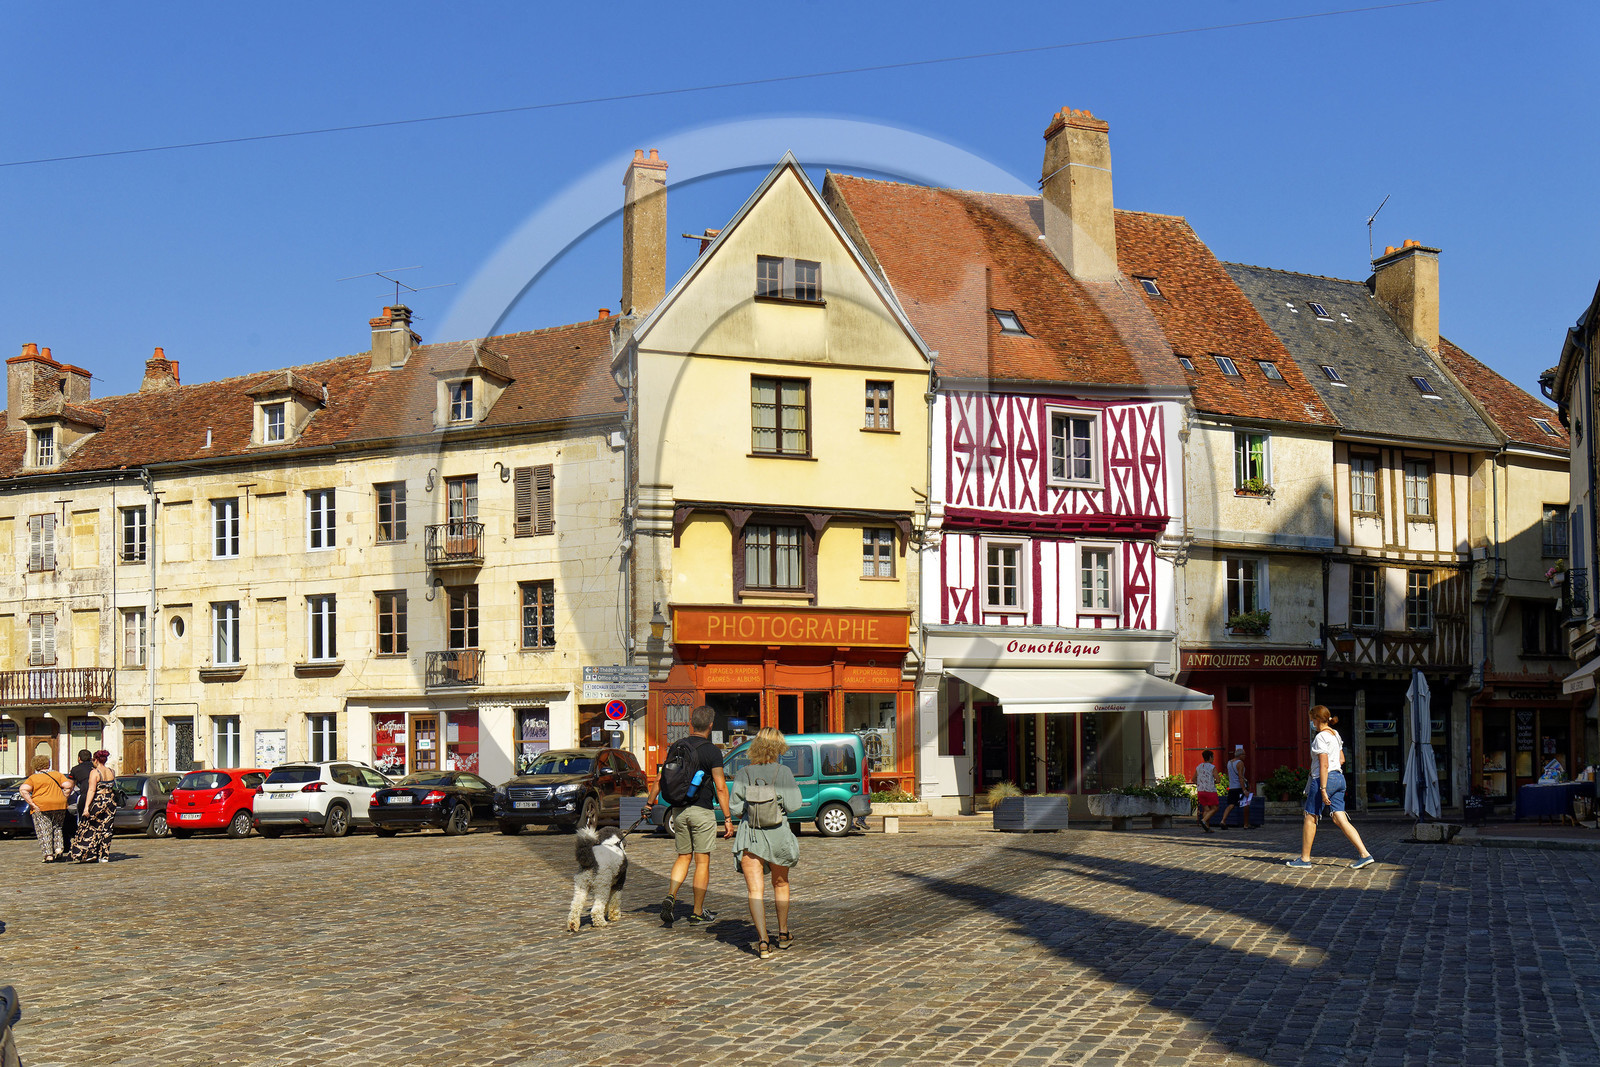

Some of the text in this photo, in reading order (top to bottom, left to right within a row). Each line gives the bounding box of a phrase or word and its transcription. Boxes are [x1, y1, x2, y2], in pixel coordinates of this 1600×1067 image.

[707, 615, 879, 641] PHOTOGRAPHE
[1006, 639, 1101, 657] Oenothèque
[1187, 654, 1250, 668] ANTIQUITES
[1263, 653, 1318, 667] BROCANTE
[709, 667, 733, 675] TIRAGES
[737, 675, 761, 683] ALBUMS
